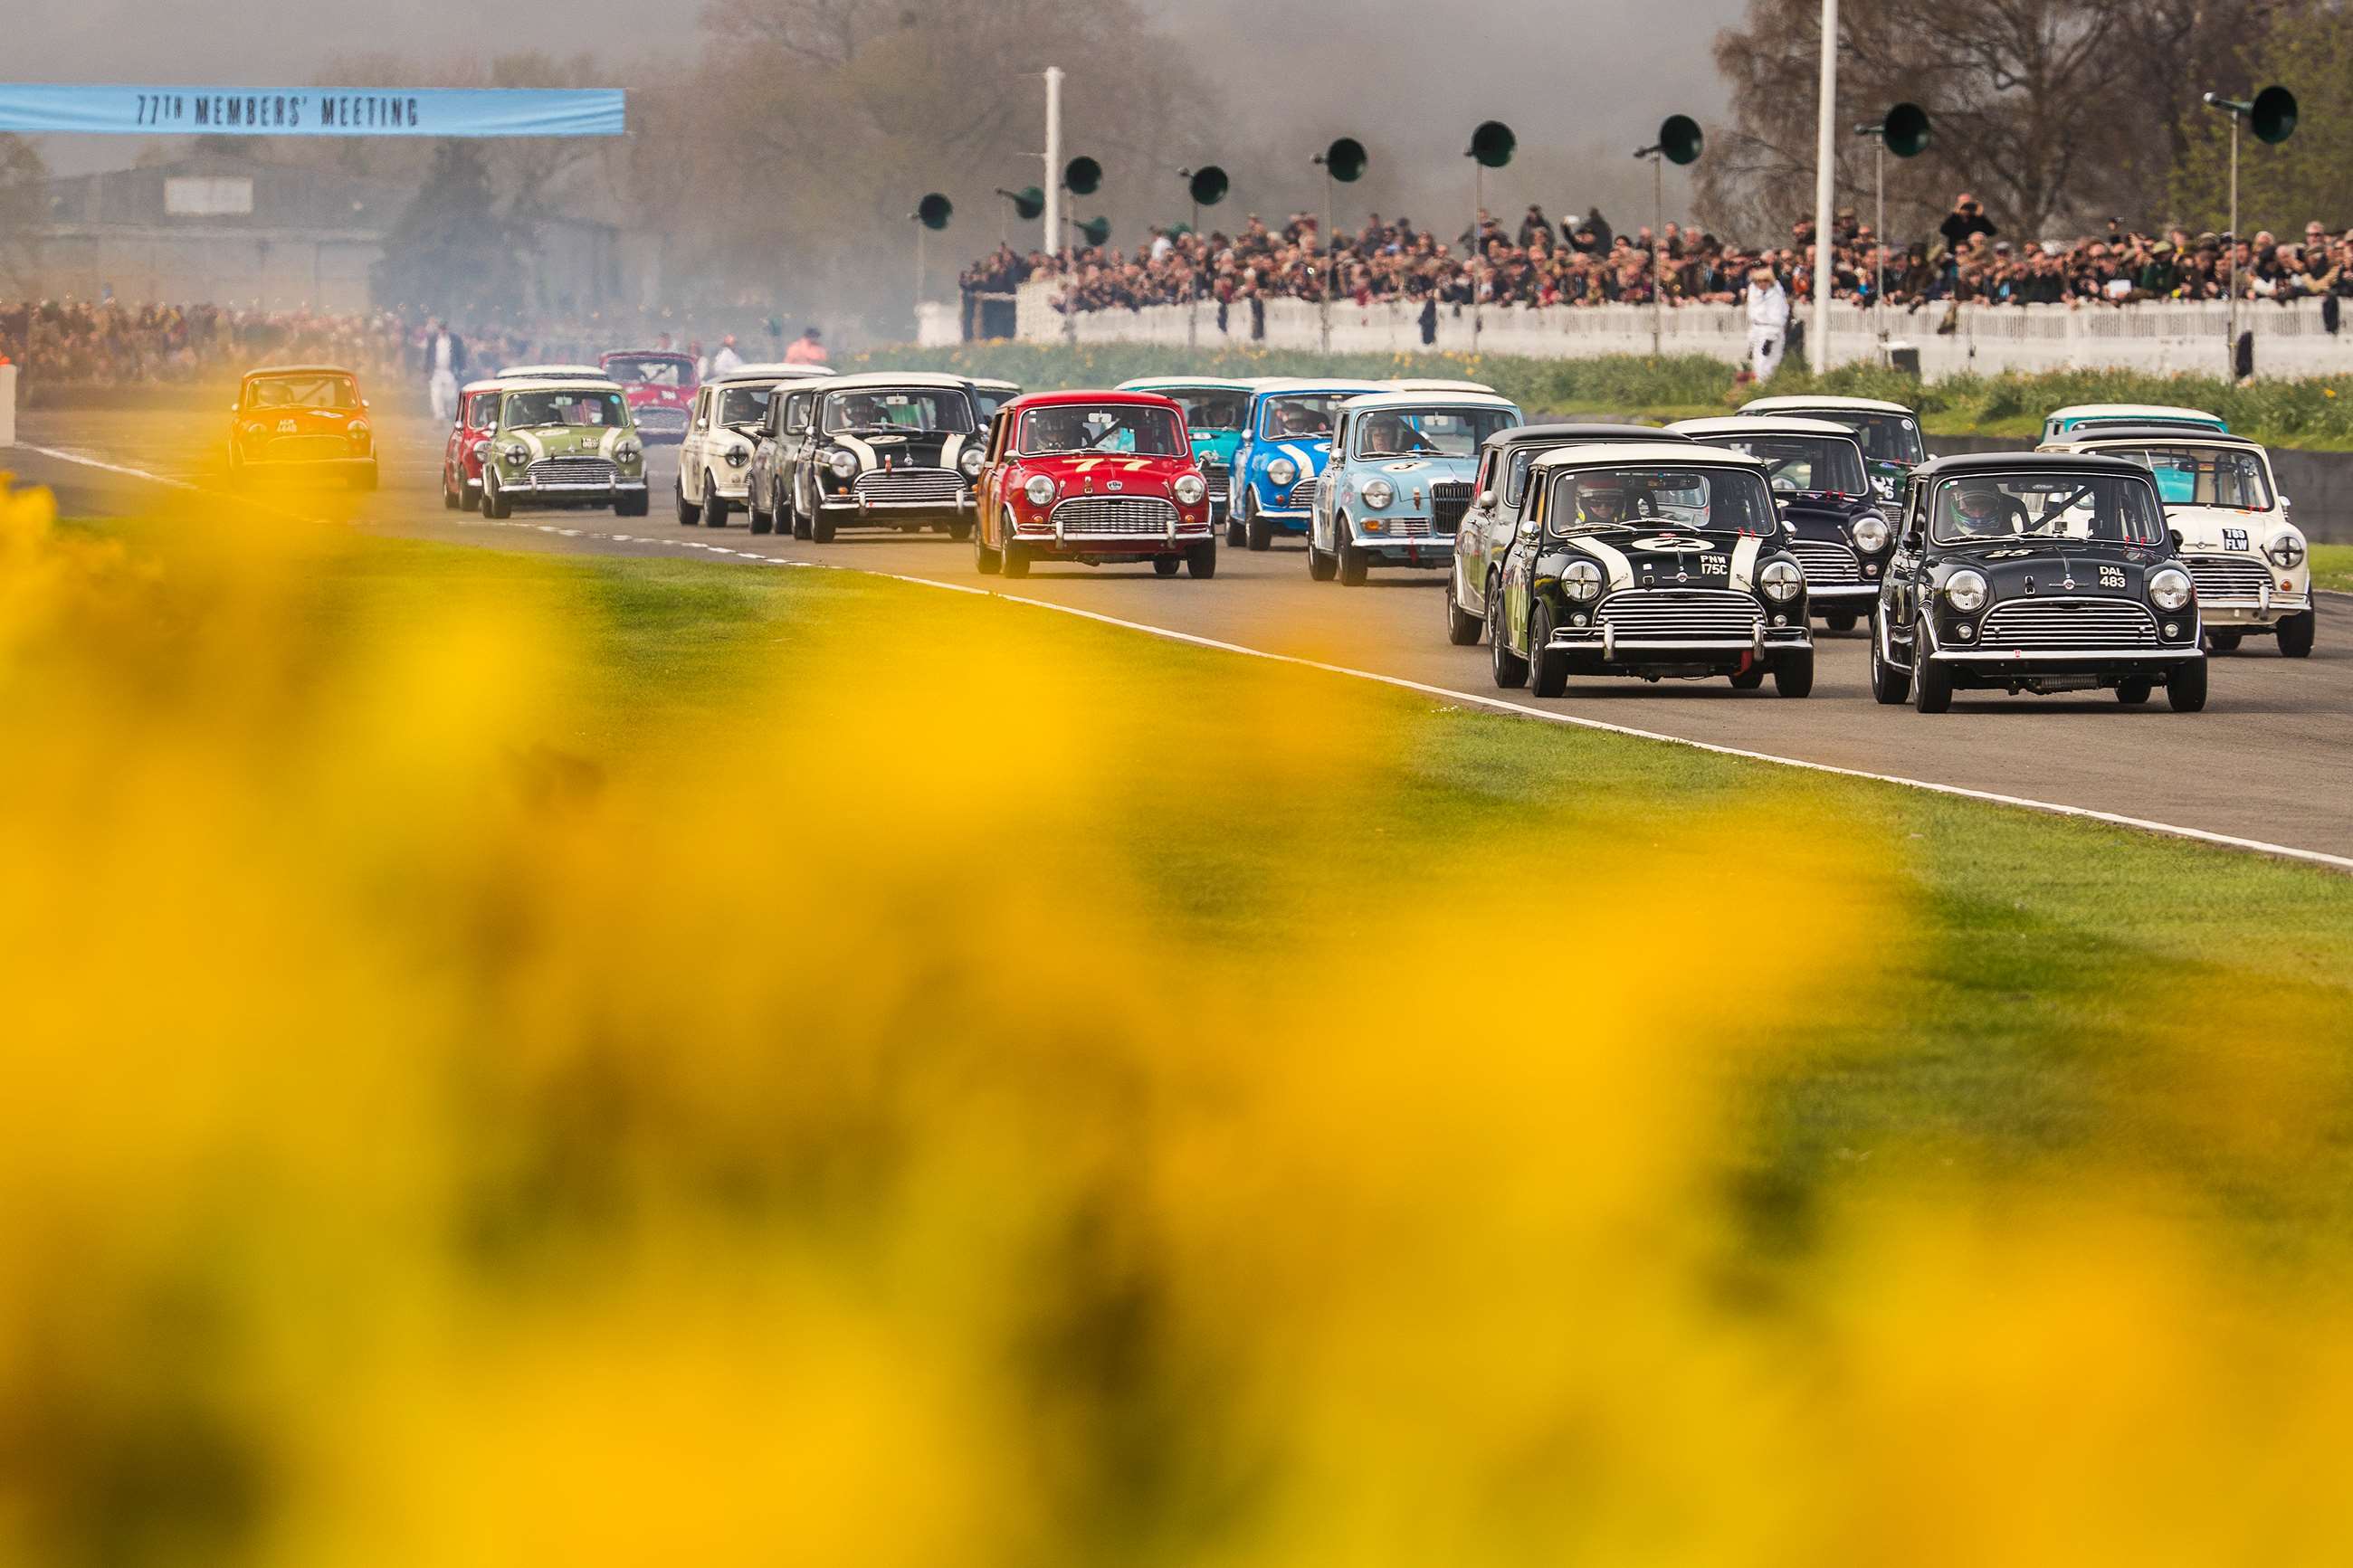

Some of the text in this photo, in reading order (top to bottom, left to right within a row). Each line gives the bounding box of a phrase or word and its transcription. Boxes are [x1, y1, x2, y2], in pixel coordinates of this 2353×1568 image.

[195, 95, 308, 127] MEMBERS'
[320, 96, 418, 127] MEETING
[1062, 458, 1153, 472] 77
[2225, 538, 2247, 550] FLW
[1700, 555, 1727, 565] PNW
[1700, 564, 1728, 575] 175C
[2099, 565, 2125, 577] DAL
[2099, 576, 2126, 588] 483
